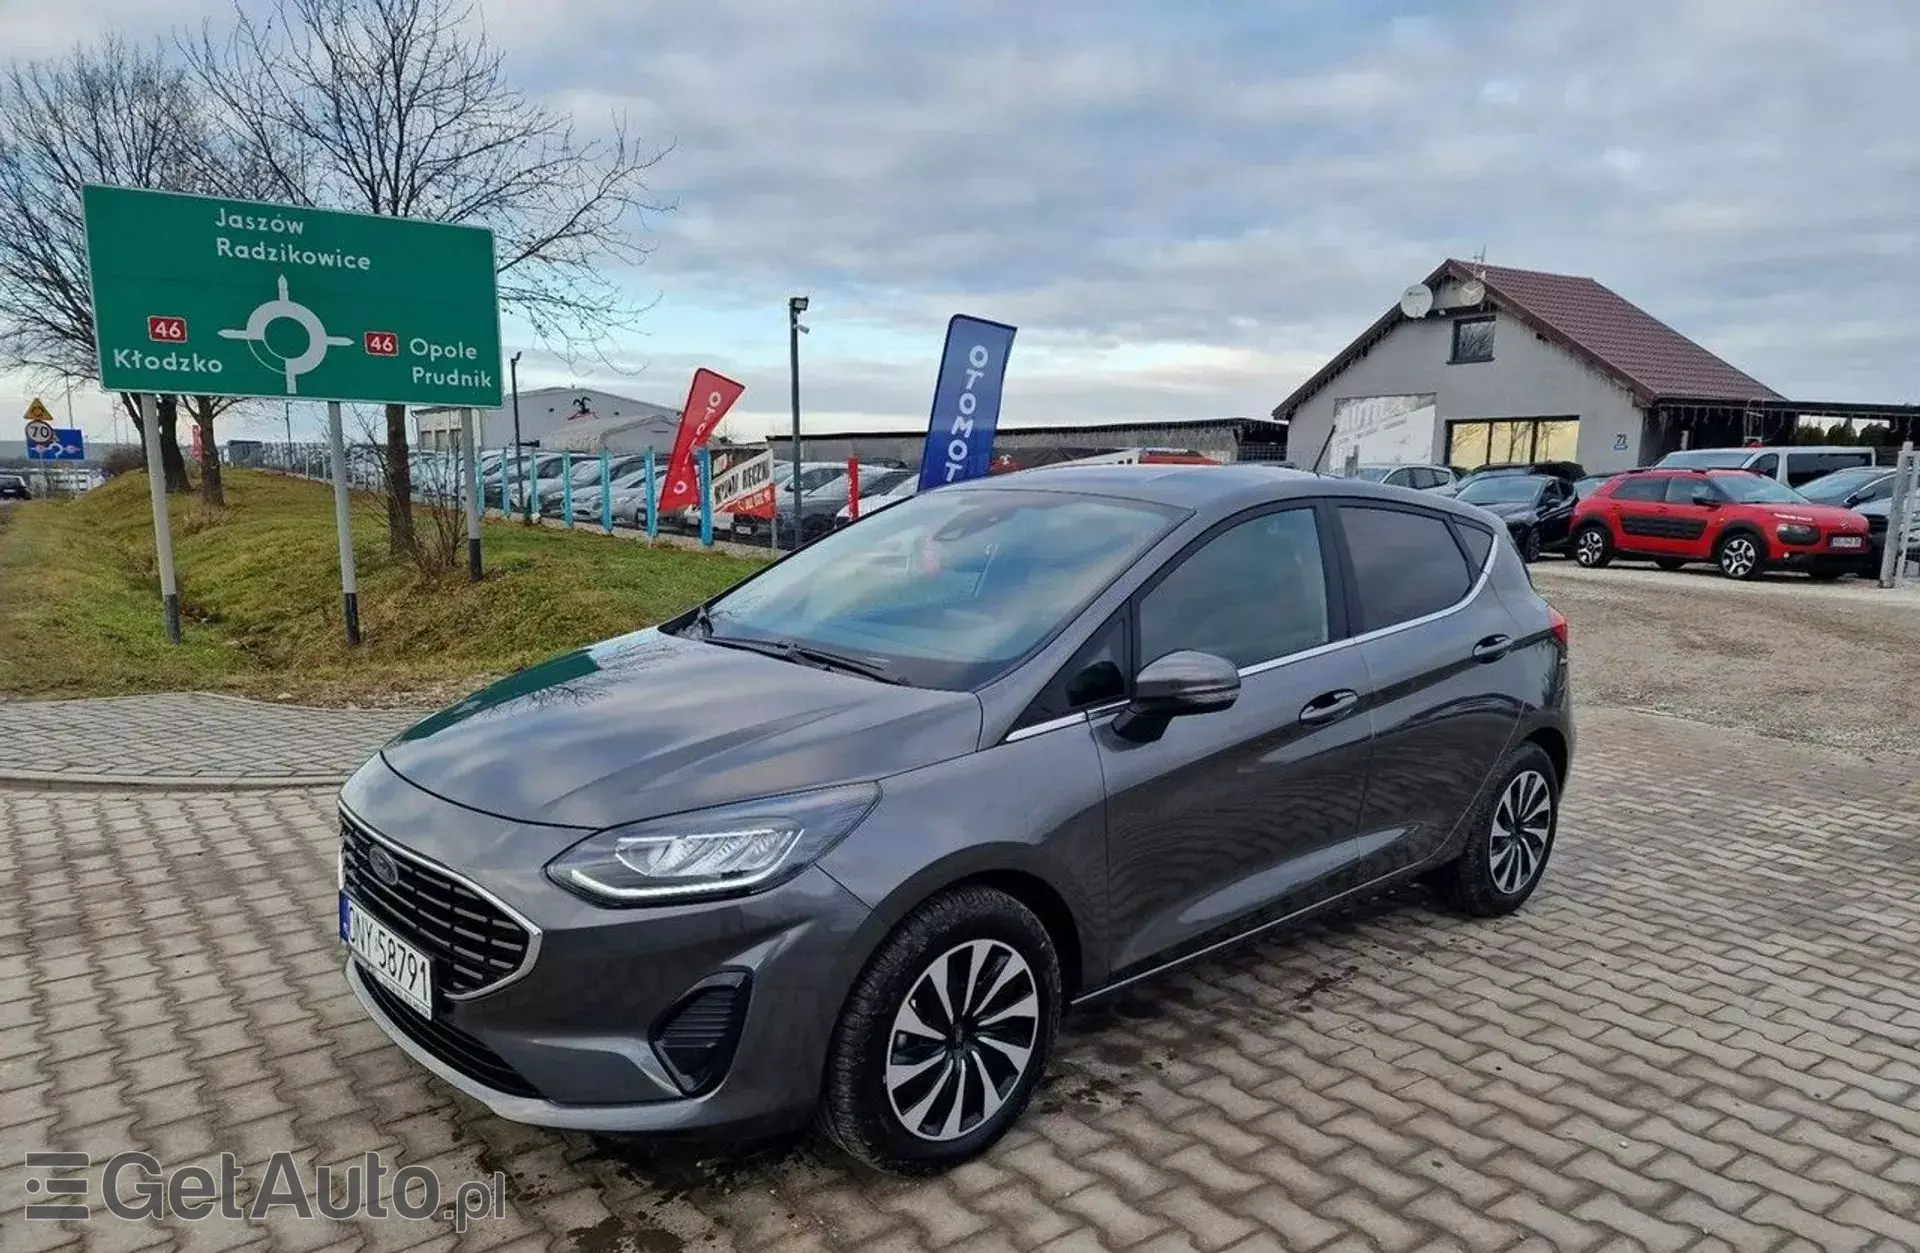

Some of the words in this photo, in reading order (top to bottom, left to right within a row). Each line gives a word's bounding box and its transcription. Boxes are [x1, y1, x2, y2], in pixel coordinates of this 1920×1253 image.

[215, 207, 304, 235] Jaszów
[216, 237, 371, 271] Radzikowice
[155, 321, 181, 338] 46
[370, 336, 393, 352] 46
[409, 337, 477, 361] Opole
[113, 348, 223, 373] Kłodzko
[412, 366, 492, 387] Prudnik
[30, 426, 49, 438] 70
[378, 928, 427, 1001] 58791
